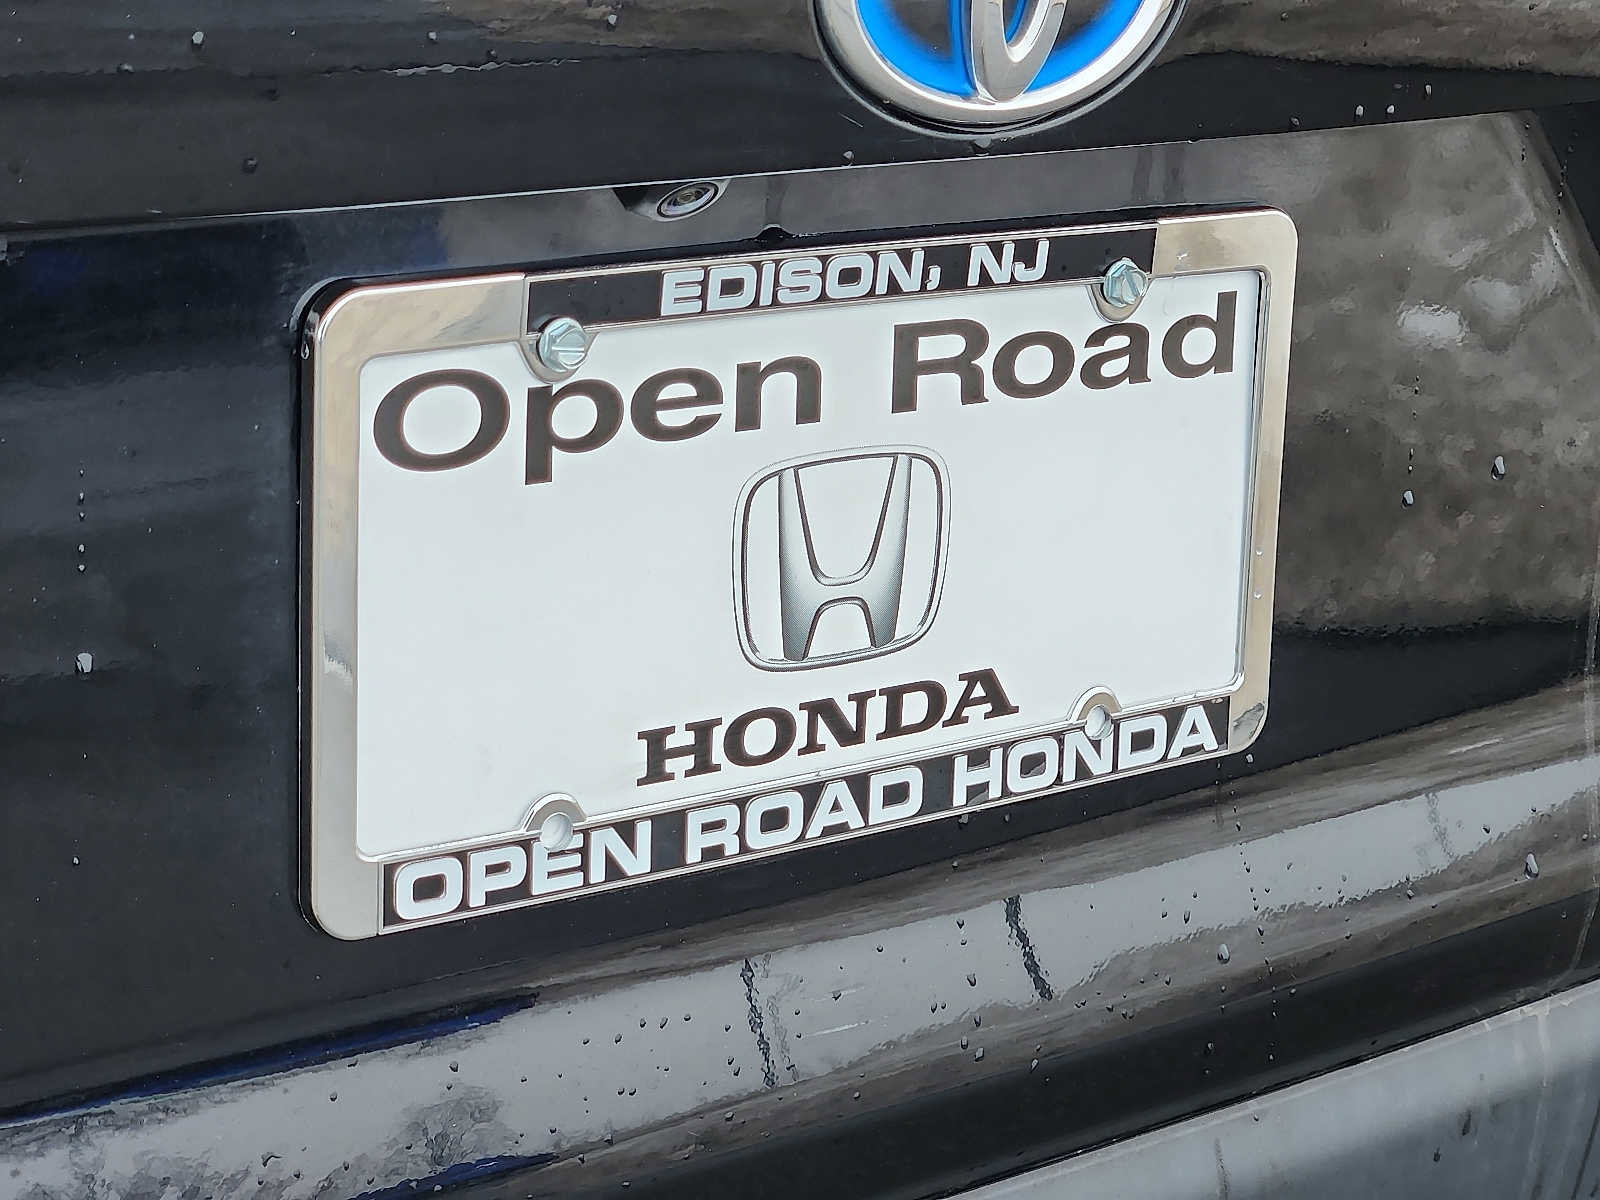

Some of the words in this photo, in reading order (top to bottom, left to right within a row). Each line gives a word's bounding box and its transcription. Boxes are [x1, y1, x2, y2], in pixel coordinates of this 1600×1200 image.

[660, 248, 941, 317] EDISON,
[967, 239, 1050, 287] NJ
[373, 355, 822, 485] Open
[892, 291, 1238, 414] Road
[637, 668, 1019, 786] HONDA
[394, 818, 652, 920] OPEN
[685, 765, 923, 864] ROAD
[952, 703, 1218, 807] HONDA
